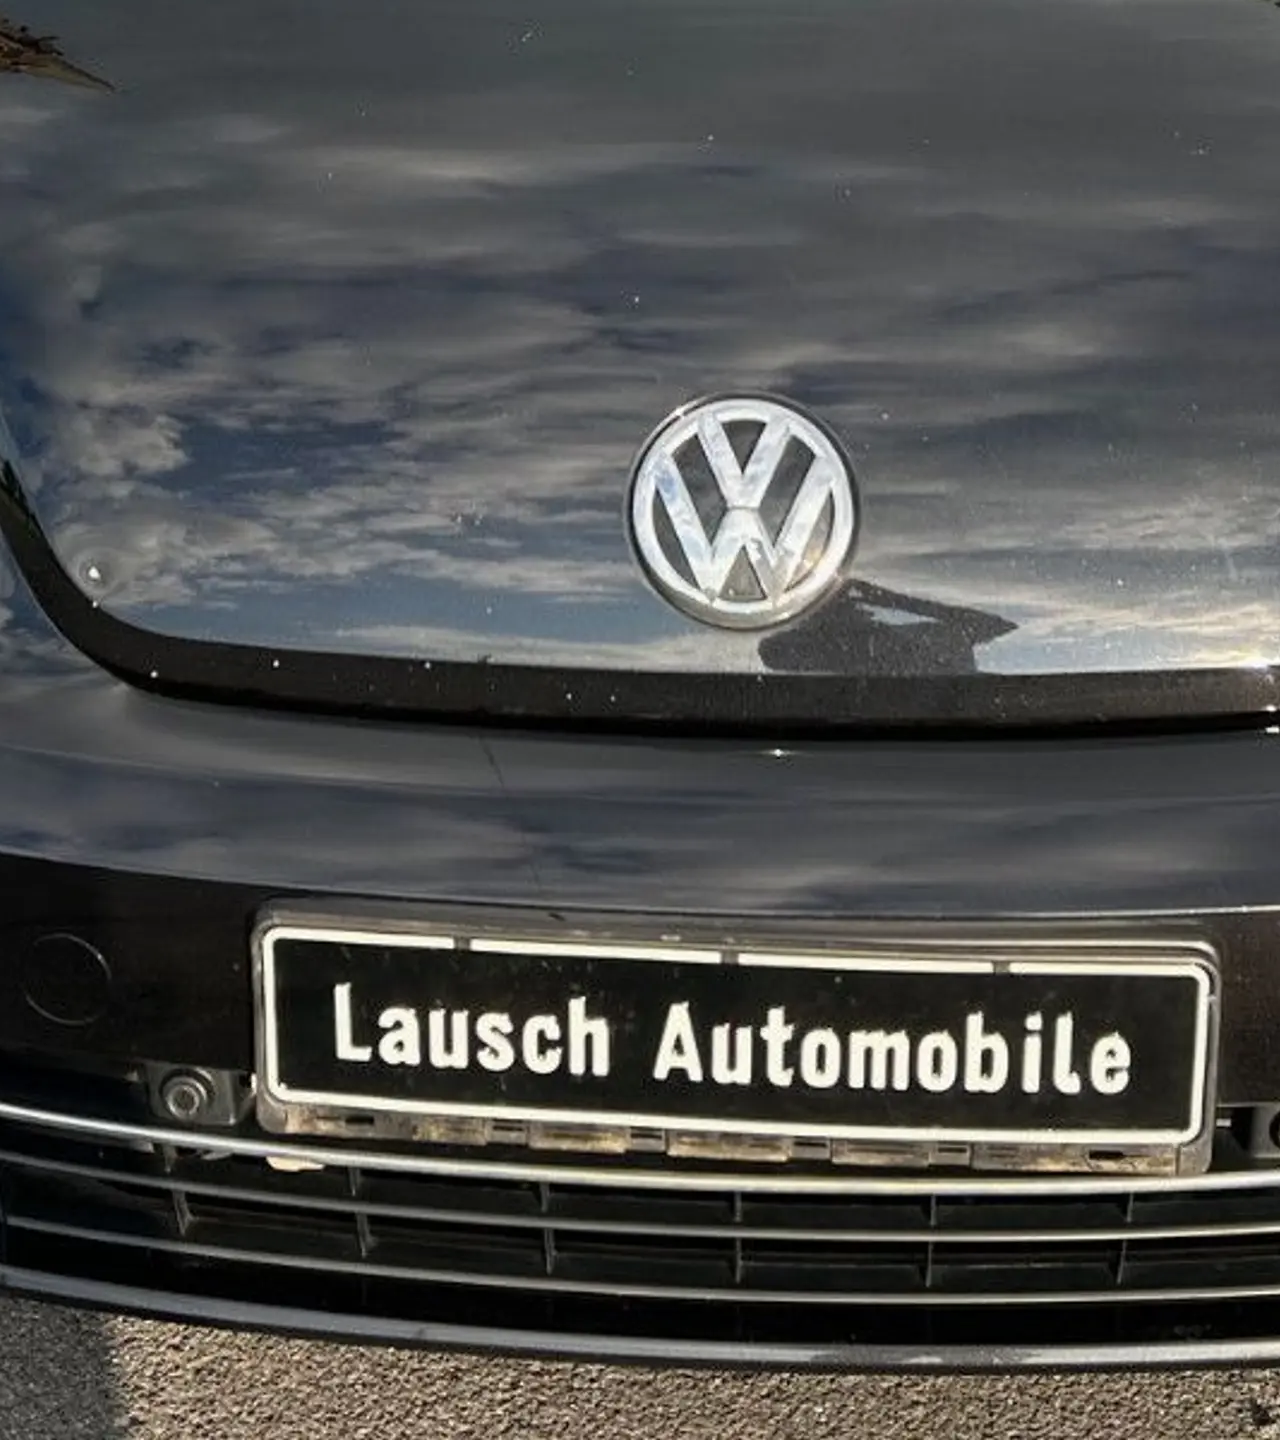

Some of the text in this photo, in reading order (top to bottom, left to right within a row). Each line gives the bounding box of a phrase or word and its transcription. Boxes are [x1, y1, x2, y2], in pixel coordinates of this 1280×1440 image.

[645, 405, 842, 614] VW
[333, 982, 1131, 1095] Lausch Automobile
